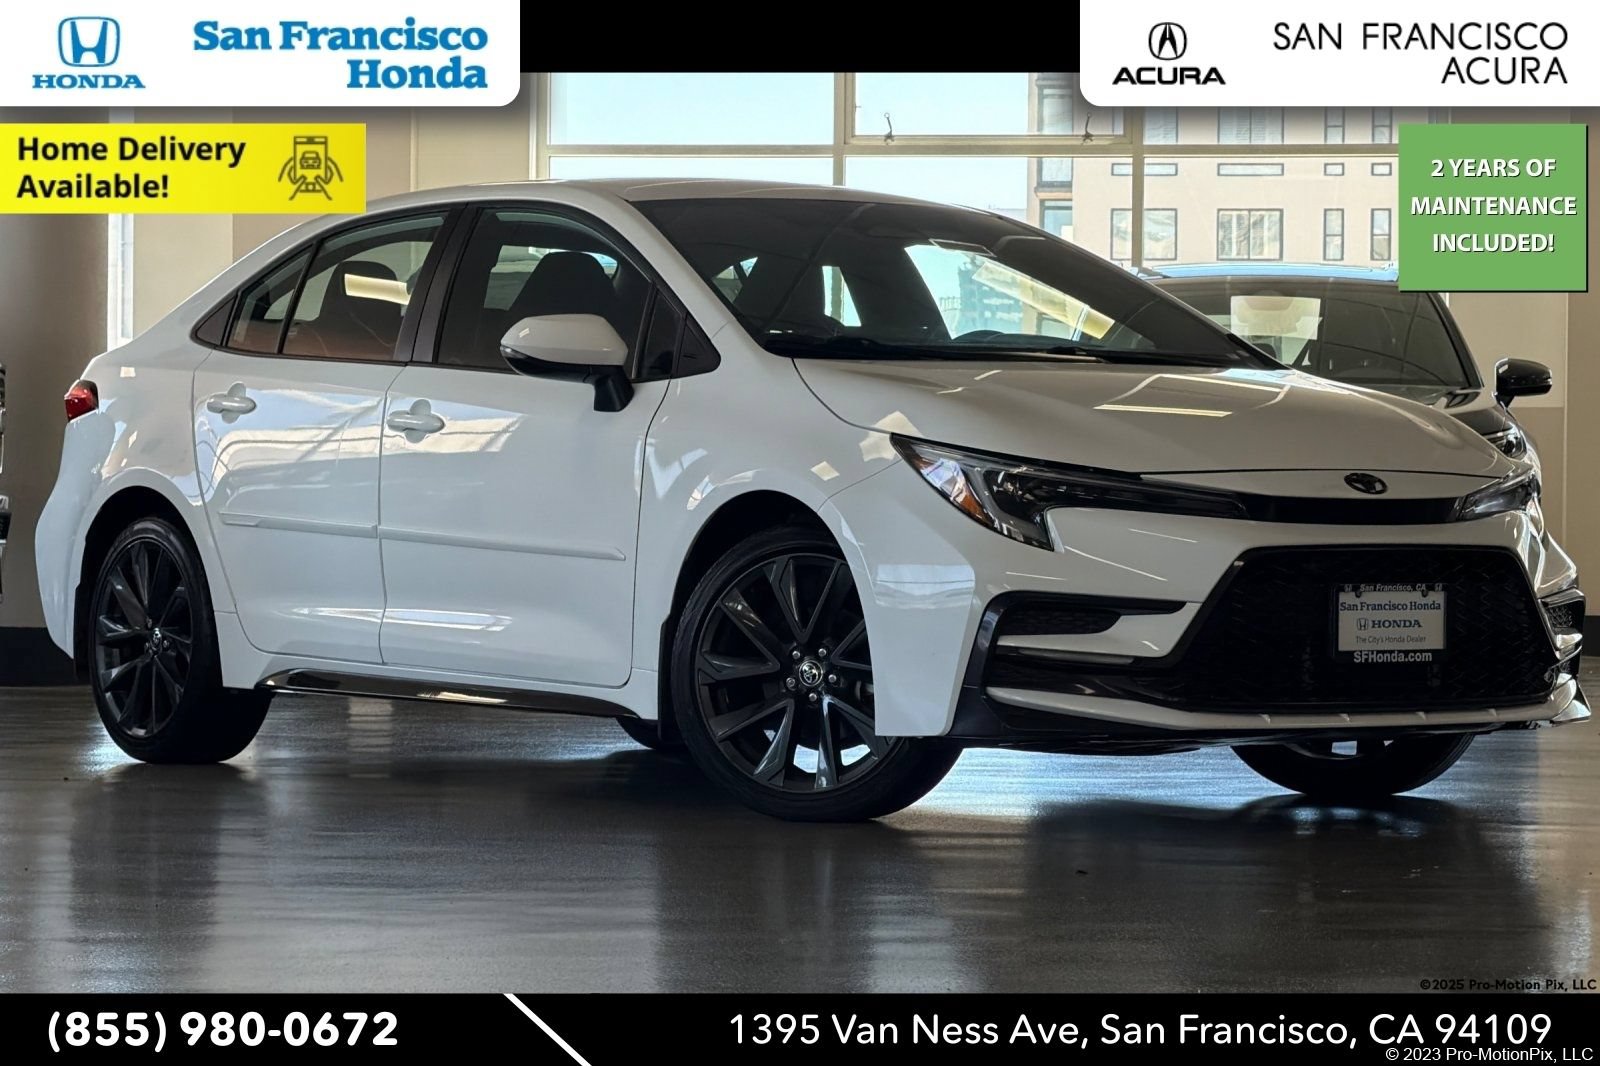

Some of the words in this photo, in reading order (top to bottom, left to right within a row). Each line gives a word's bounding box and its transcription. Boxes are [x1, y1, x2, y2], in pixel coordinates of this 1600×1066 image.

[1360, 584, 1374, 592] San
[1340, 602, 1359, 611] San
[1360, 601, 1407, 611] Francisco
[1410, 600, 1441, 611] Honda
[1371, 619, 1422, 629] HONDA
[1356, 636, 1366, 644] The
[1385, 635, 1405, 643] Honda
[1407, 635, 1426, 643] Dealer
[1354, 651, 1432, 663] SFHonda.com
